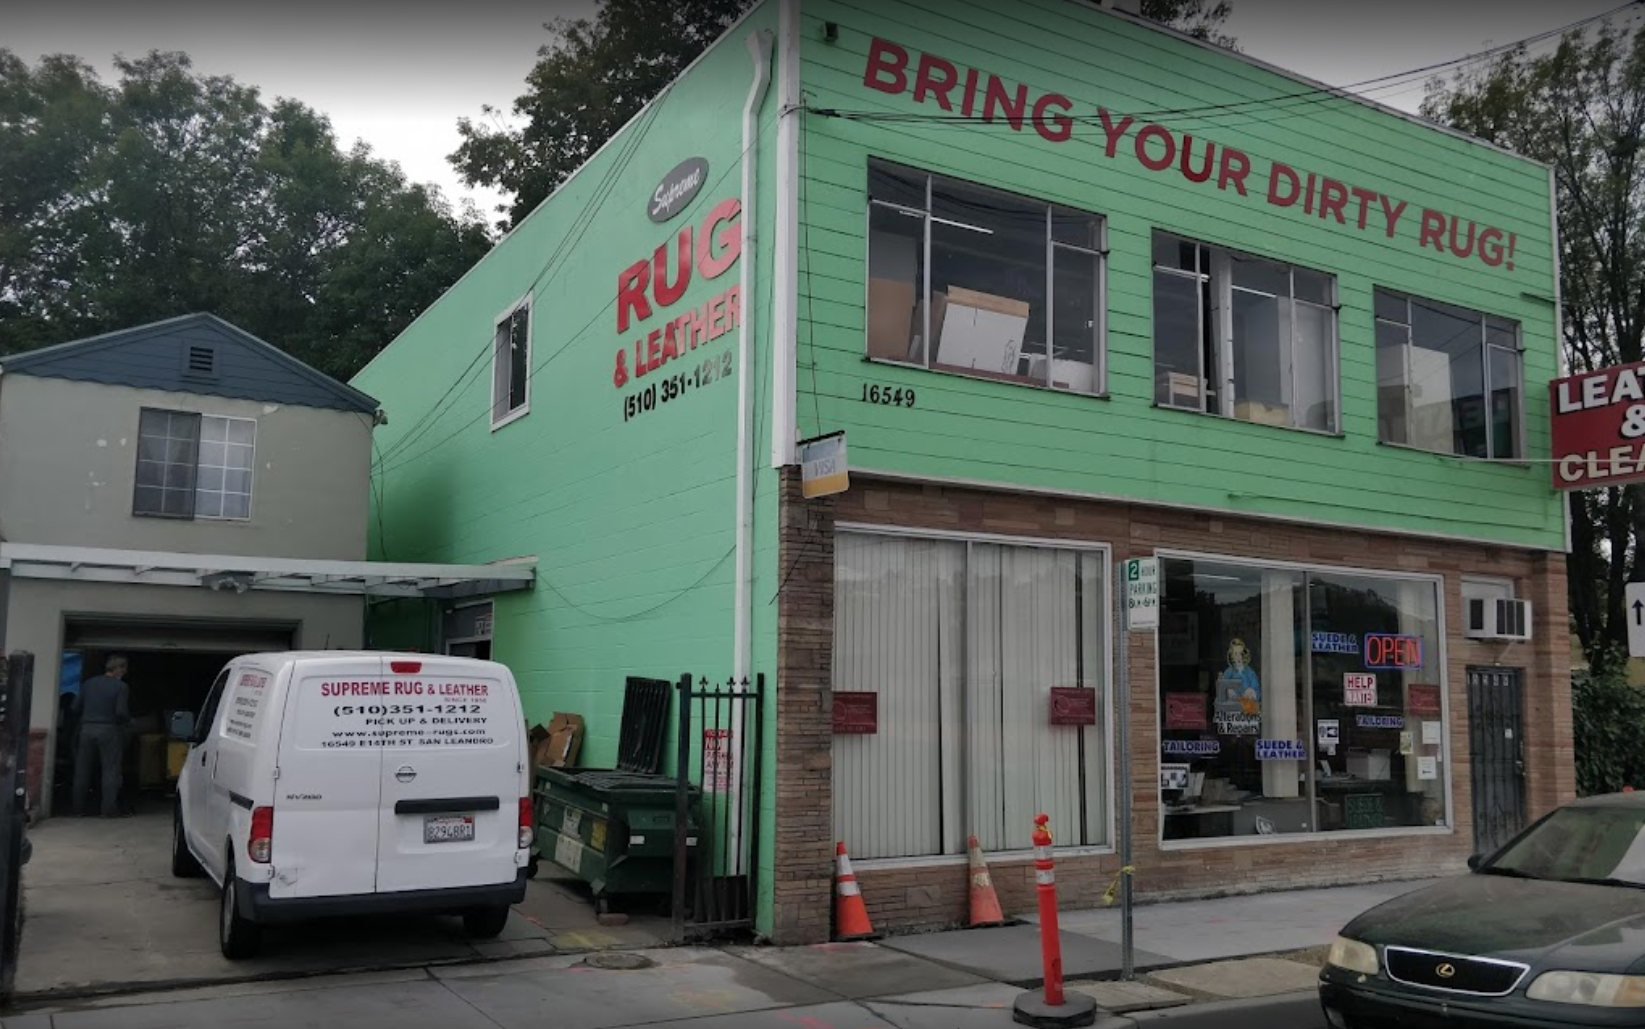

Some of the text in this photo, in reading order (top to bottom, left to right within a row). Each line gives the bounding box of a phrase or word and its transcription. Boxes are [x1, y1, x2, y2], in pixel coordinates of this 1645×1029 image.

[863, 37, 1517, 271] BRING YOUR DIRTY RUG!
[652, 167, 700, 215] Supreme
[617, 197, 741, 334] RUG
[613, 283, 741, 388] & LEATHER
[861, 383, 915, 408] 16549
[624, 383, 656, 422] (510)
[1621, 404, 1645, 437] &
[1559, 443, 1645, 481] CLE
[1312, 633, 1347, 642] SUEDE
[1312, 643, 1358, 652] LEATHER
[1368, 636, 1420, 665] OPEN
[321, 681, 489, 696] SUPREME RUG & LEATHER
[1348, 677, 1373, 688] HELP
[333, 704, 482, 716] (510)351-1212
[432, 717, 488, 725] DELIVERY
[1357, 715, 1403, 727] TAILORING
[321, 740, 356, 748] 16549
[399, 738, 414, 746] ST
[445, 737, 494, 745] LEANDRO
[1164, 741, 1219, 752] TAILORING
[1257, 740, 1293, 750] SUEDE
[1257, 750, 1306, 759] LEATHER
